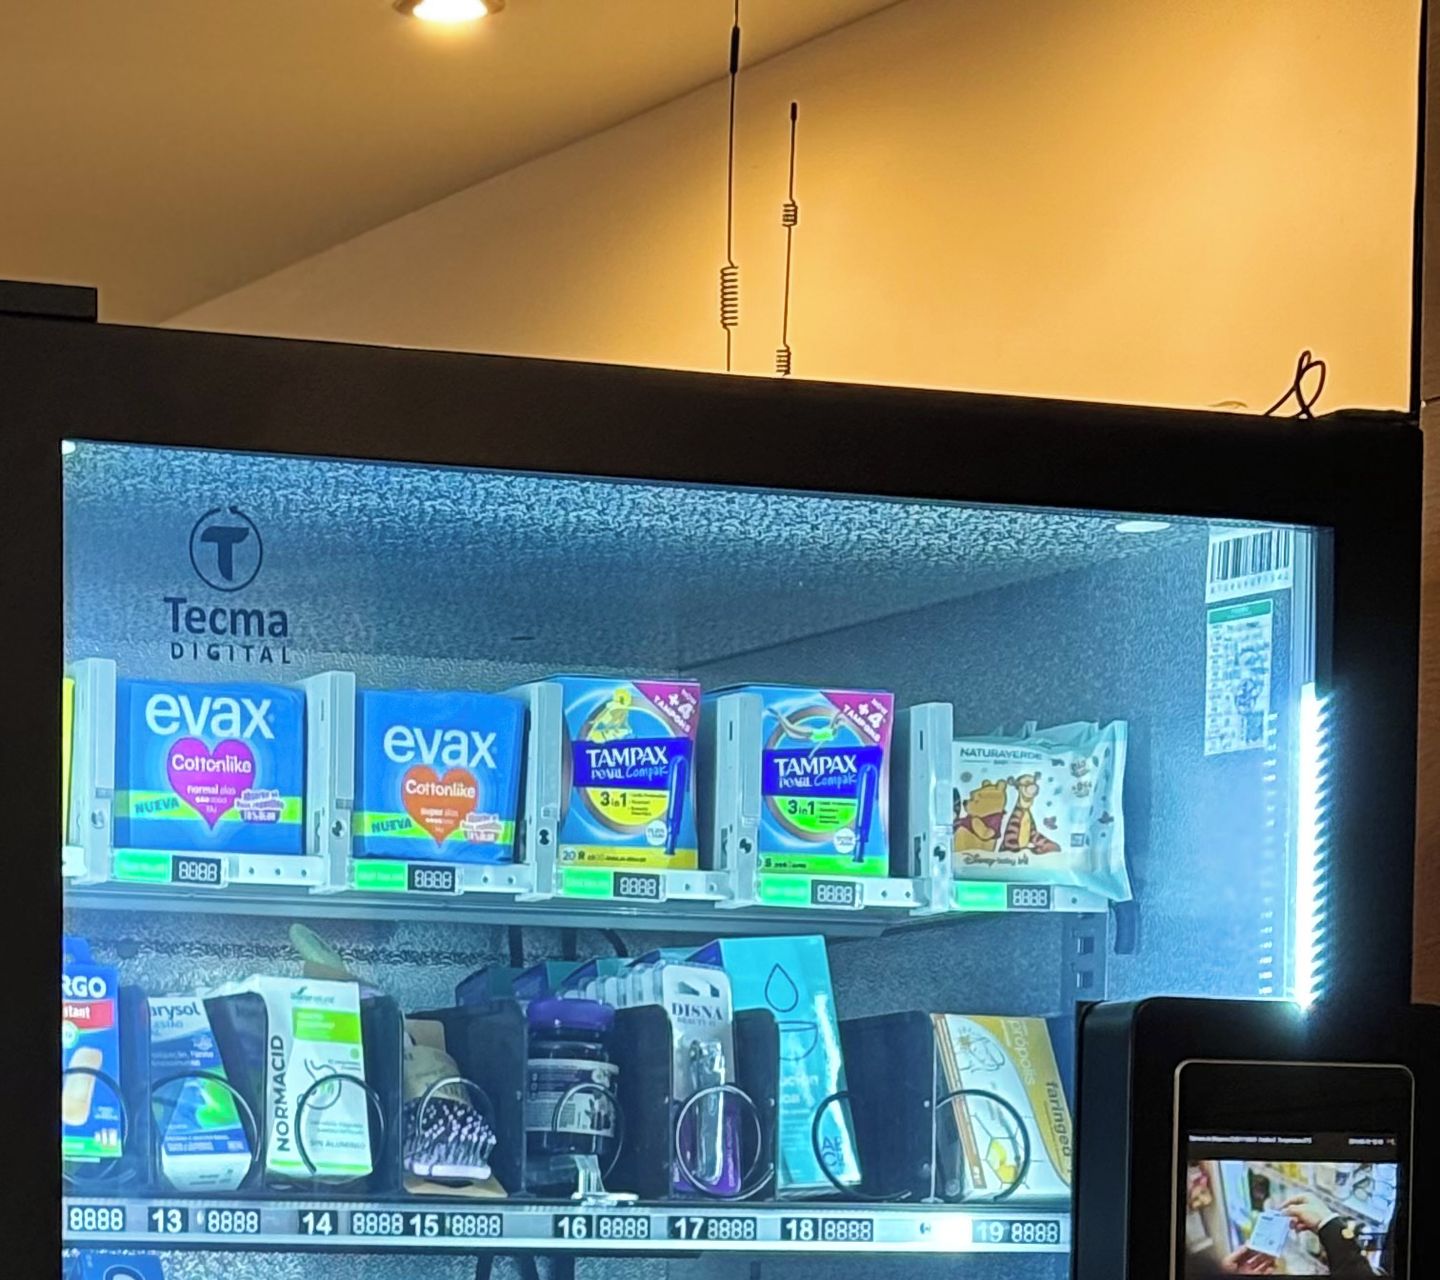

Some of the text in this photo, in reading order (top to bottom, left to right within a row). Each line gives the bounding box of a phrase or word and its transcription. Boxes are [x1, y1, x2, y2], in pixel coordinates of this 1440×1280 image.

[164, 597, 288, 637] Tecma
[171, 642, 291, 664] DIGITAL
[145, 693, 275, 740] evax
[383, 726, 496, 768] evax
[586, 746, 669, 768] TAMPAX
[172, 754, 252, 774] Cottonlike
[774, 755, 858, 777] TAMPAX
[405, 779, 476, 798] Cottonlike
[134, 797, 180, 814] NUEVA
[371, 817, 413, 833] NUEVA
[671, 1002, 723, 1021] DISNA
[271, 1034, 291, 1152] NORMACID
[69, 1207, 1059, 1242] 8888 13 8888 14 8888 15 16 8888 17 8888 18 8888 19 8888
